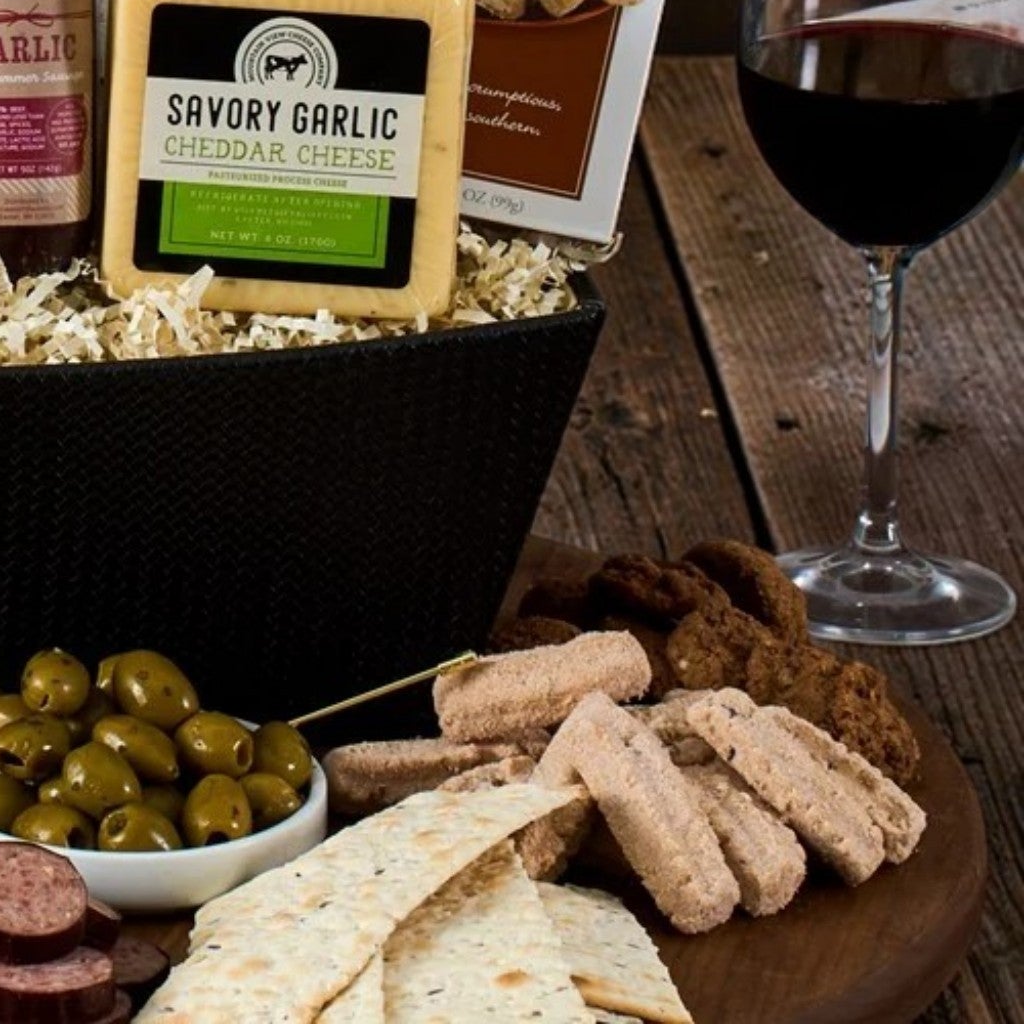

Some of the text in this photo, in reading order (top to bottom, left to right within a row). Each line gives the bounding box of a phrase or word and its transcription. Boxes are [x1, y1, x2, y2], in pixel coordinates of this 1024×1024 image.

[265, 31, 286, 41] VIEW
[288, 31, 314, 48] CHEESE
[167, 93, 399, 141] SAVORY GARLIC
[164, 135, 396, 172] CHEDDAR CHEESE
[207, 170, 349, 189] PASTEURIZED PROCESS CHEESE
[189, 190, 268, 204] REFRIGERATE
[209, 230, 235, 241] NET
[239, 231, 258, 241] WT
